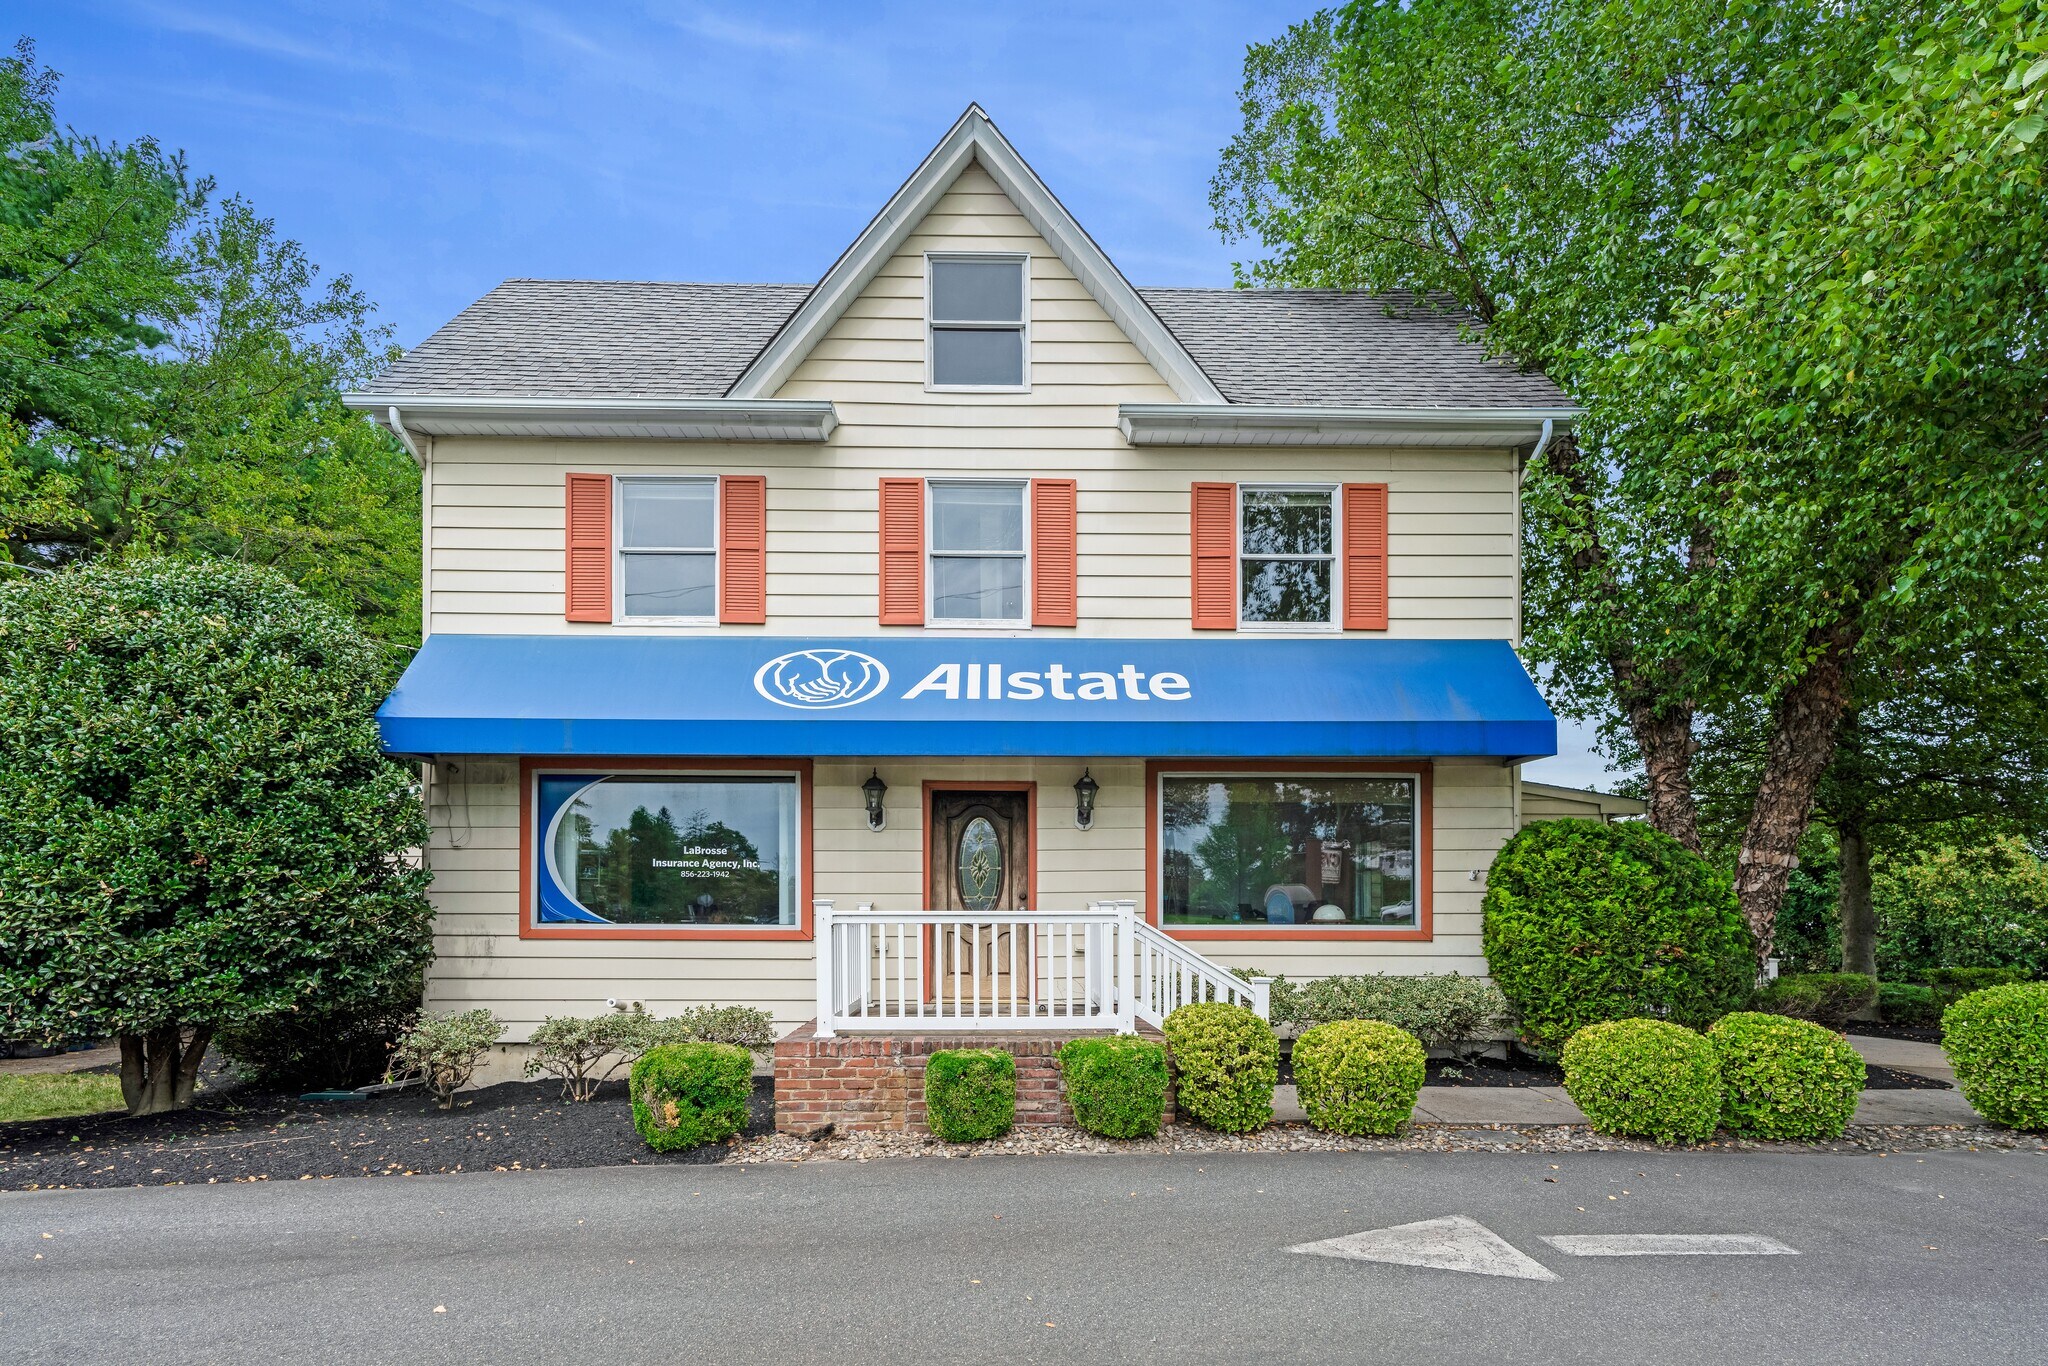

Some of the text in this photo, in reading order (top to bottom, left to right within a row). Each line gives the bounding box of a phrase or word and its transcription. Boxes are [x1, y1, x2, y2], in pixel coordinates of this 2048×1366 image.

[900, 663, 1193, 701] Allstate
[683, 845, 728, 855] LaBrosse
[652, 858, 761, 870] Insurance Agency, Inc.
[680, 870, 730, 878] 856-223-1942
